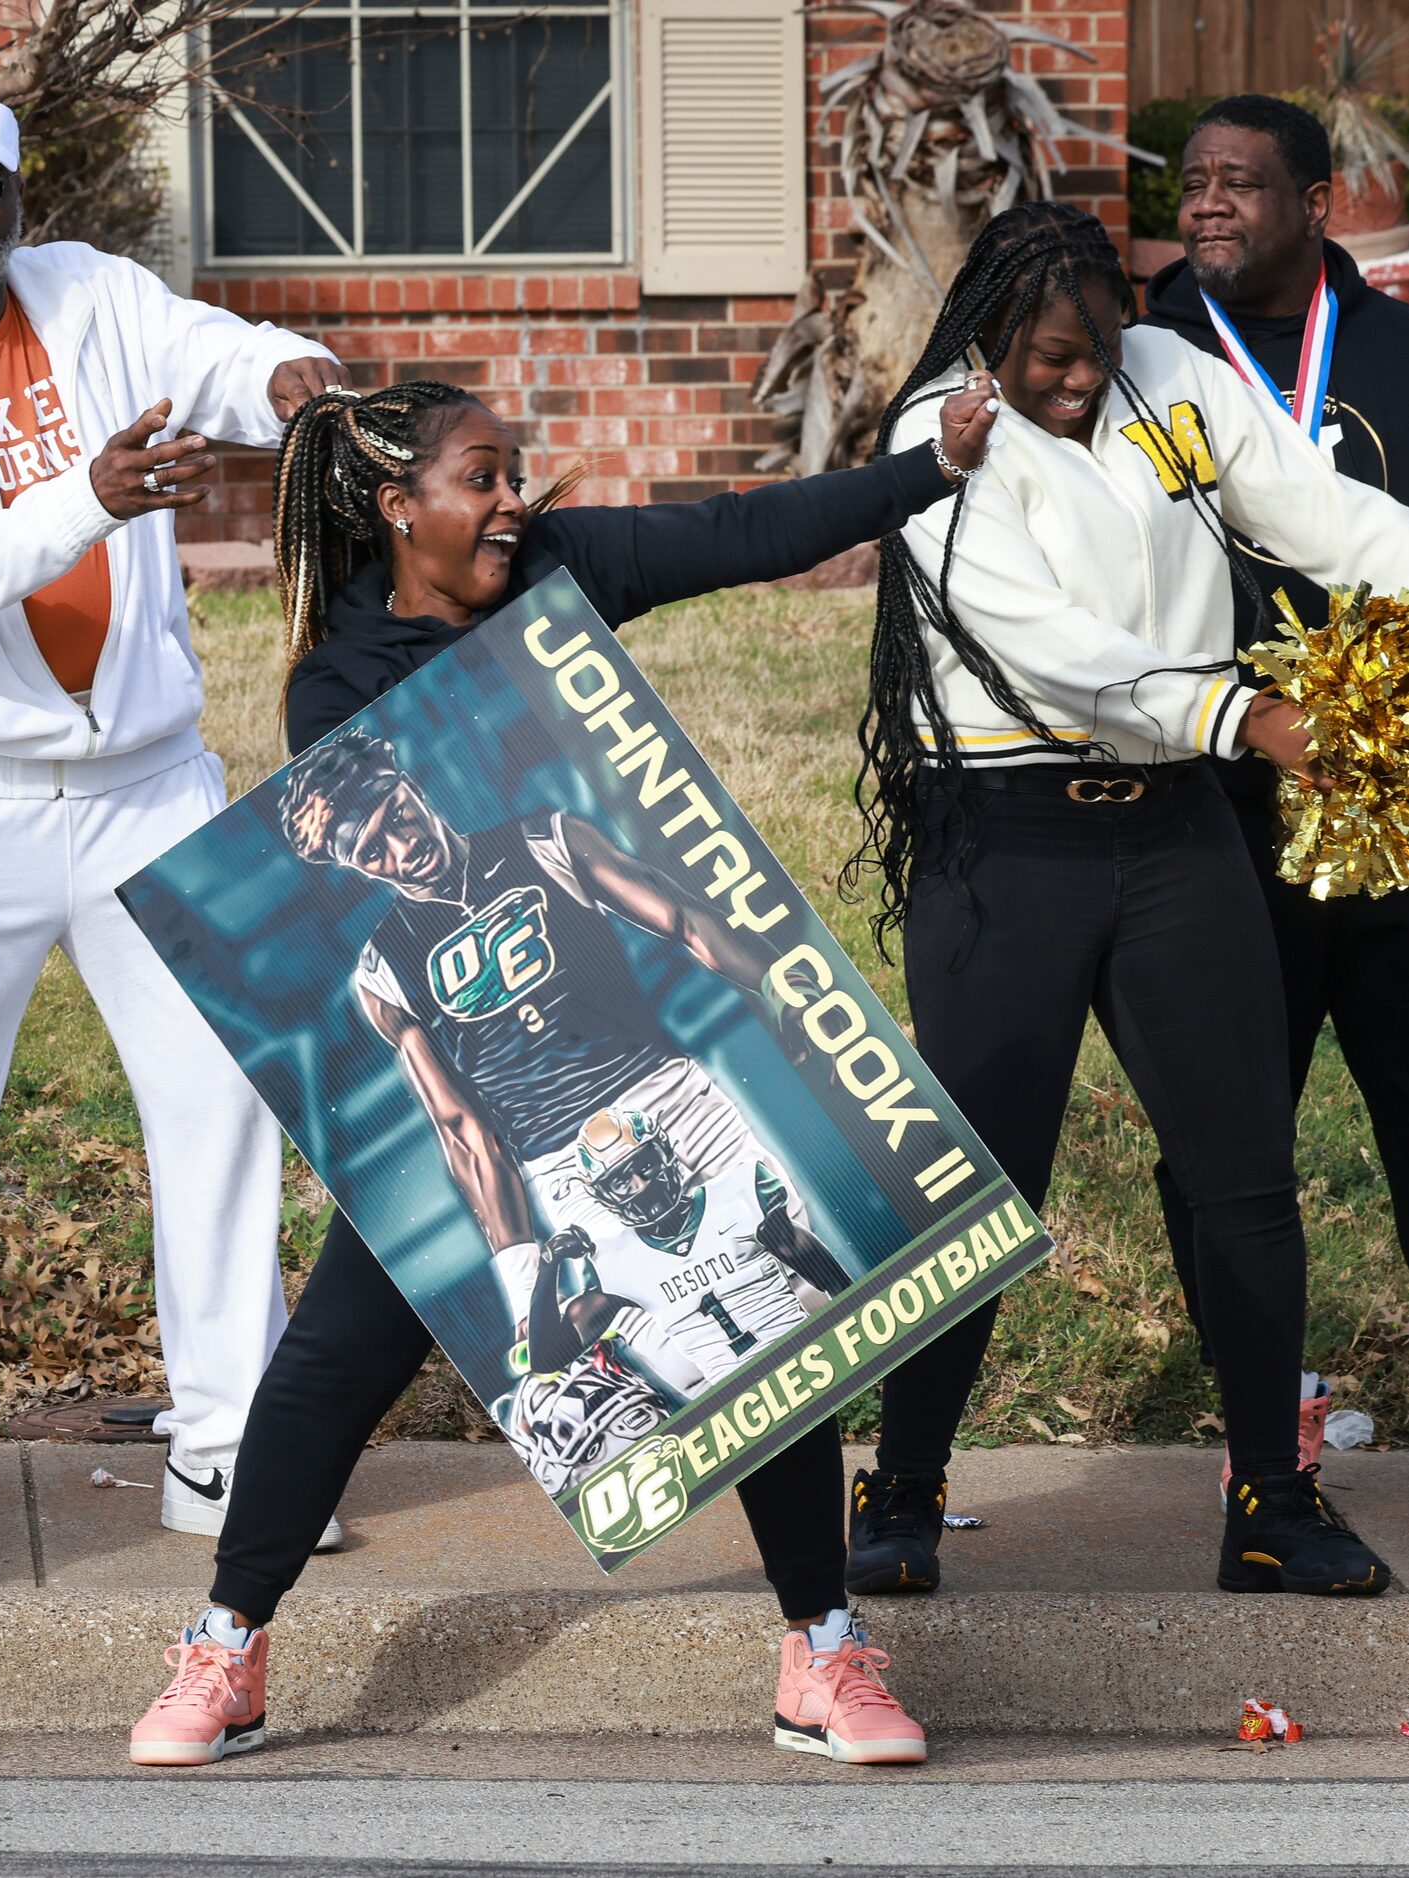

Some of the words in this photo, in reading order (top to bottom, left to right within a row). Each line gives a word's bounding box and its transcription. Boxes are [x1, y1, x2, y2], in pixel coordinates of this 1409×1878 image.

[24, 376, 64, 426] 'E
[523, 615, 790, 933] JOHNTAY
[769, 944, 939, 1152] COOK
[913, 1146, 976, 1203] II
[517, 1003, 545, 1034] 3
[659, 1252, 736, 1304] DESOTO
[680, 1343, 835, 1479] EAGLES
[833, 1199, 1036, 1368] FOOTBALL
[696, 1289, 759, 1358] 1
